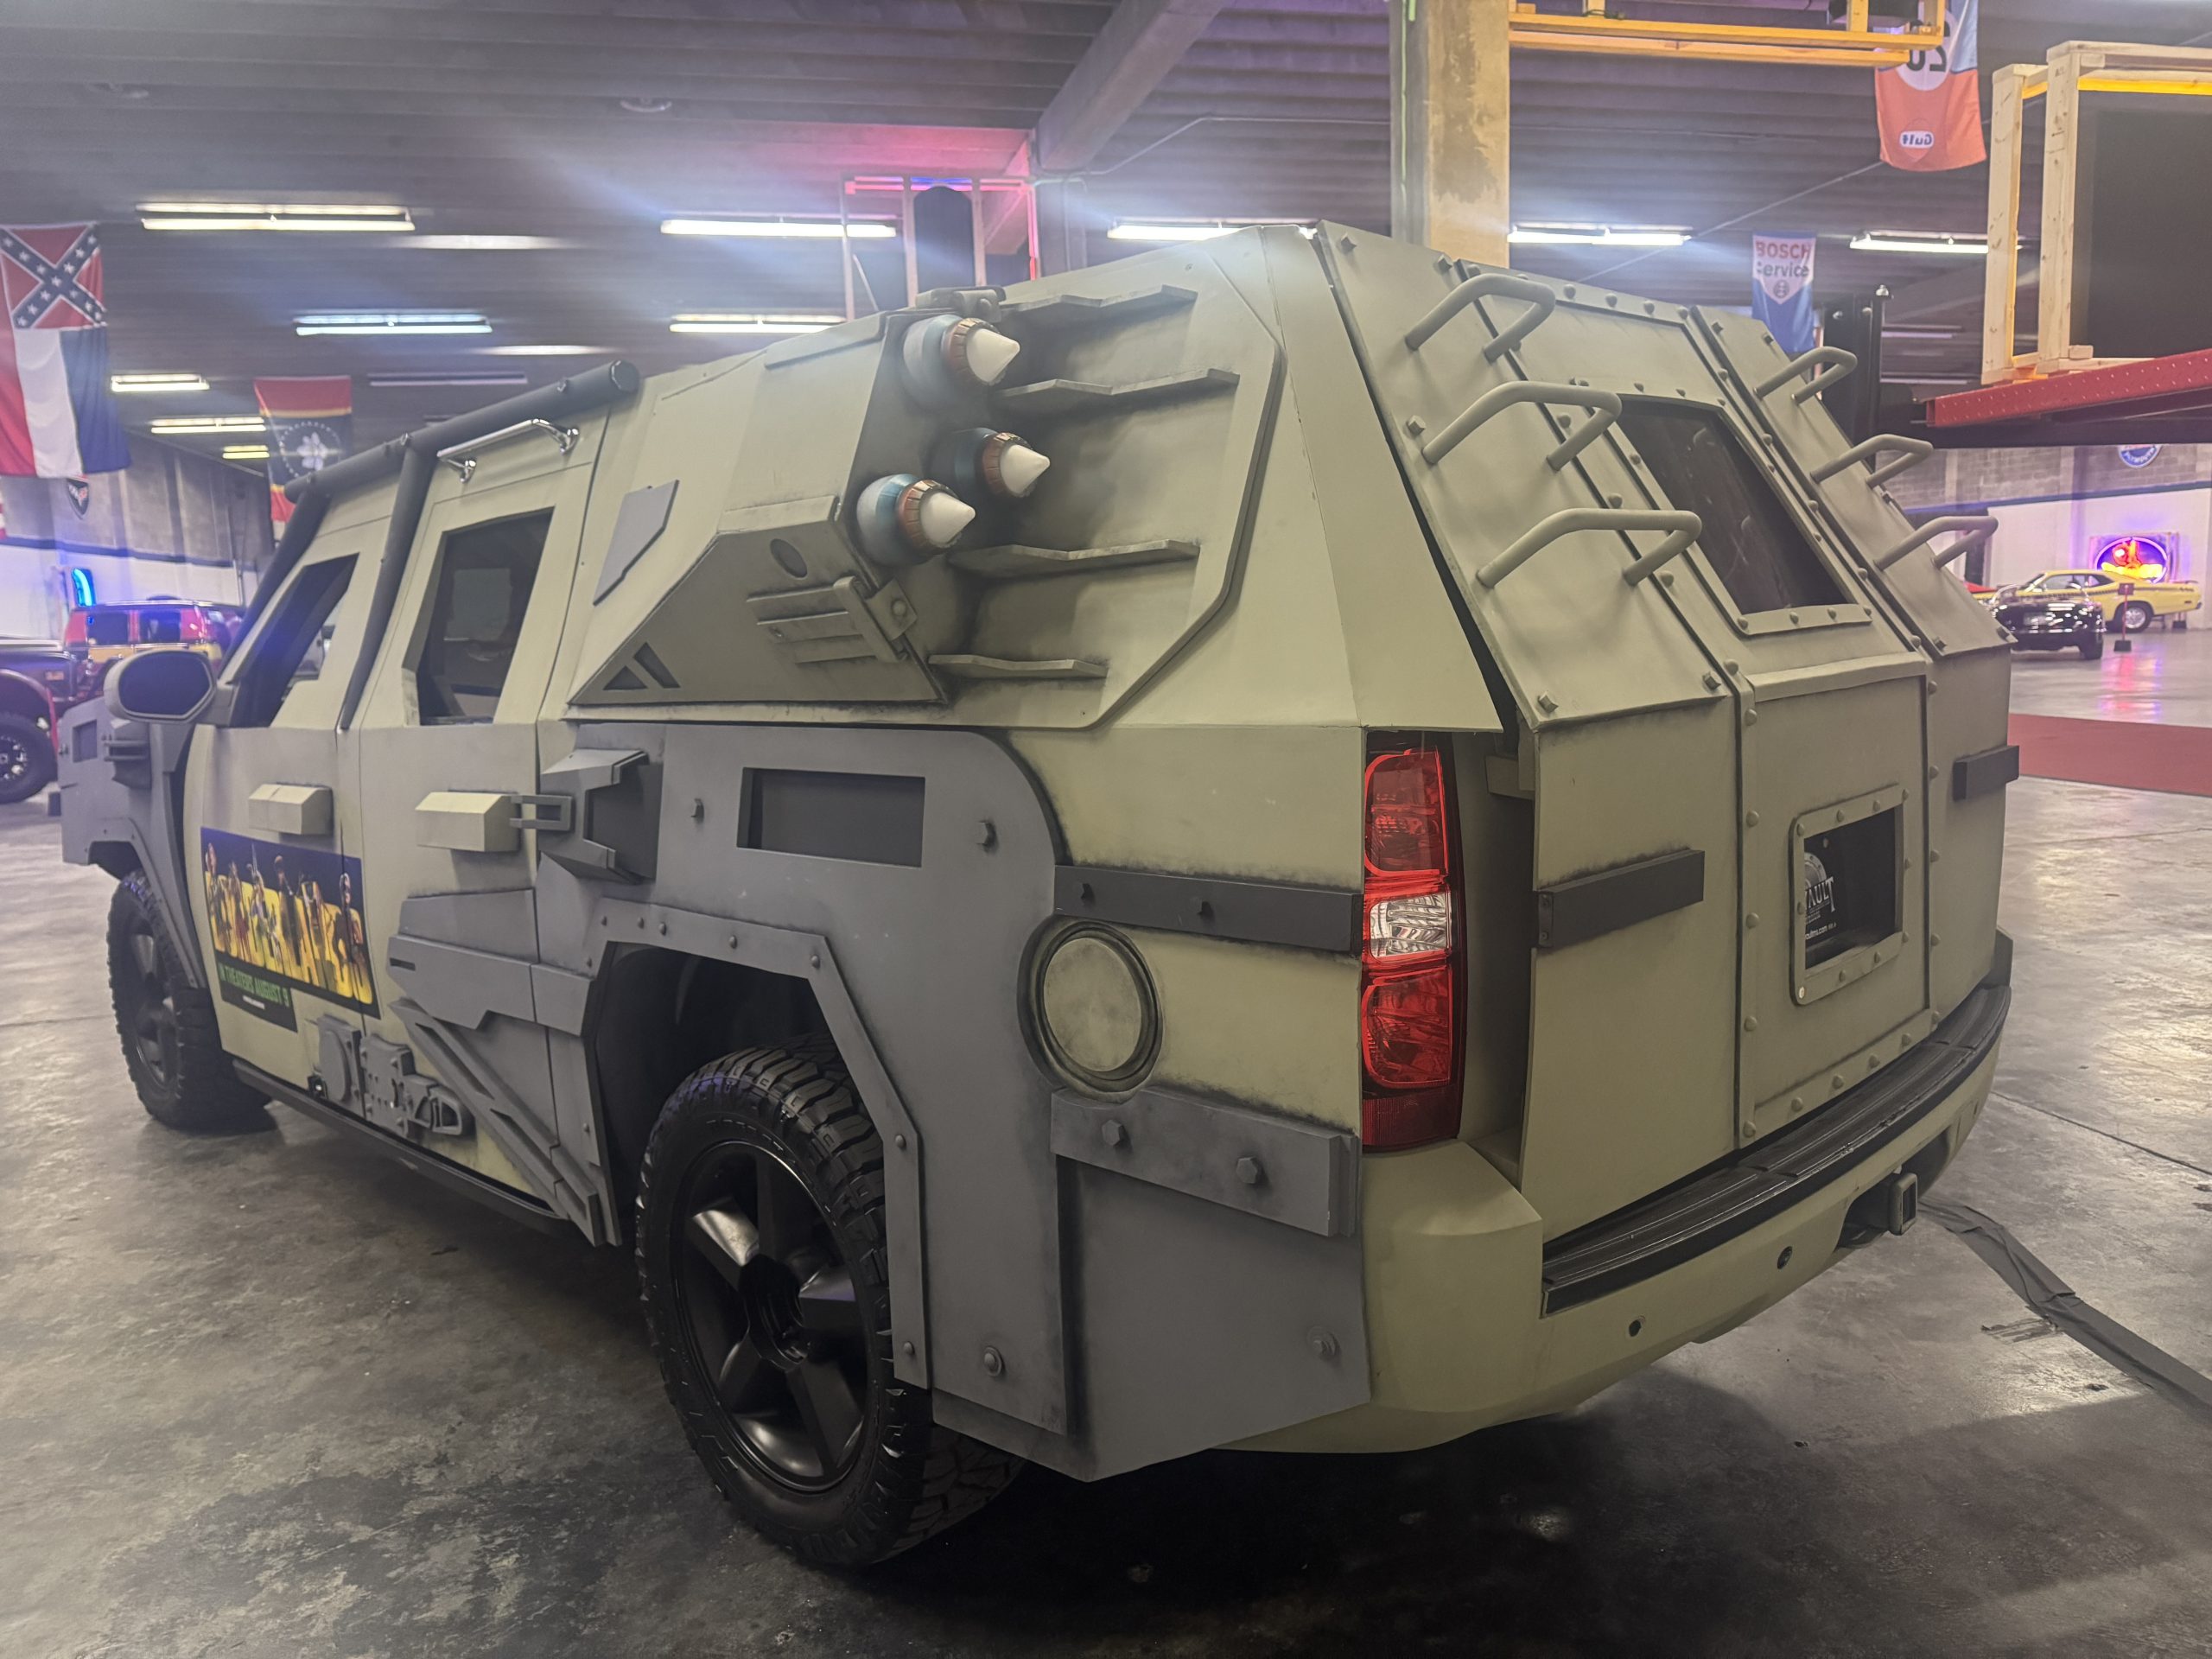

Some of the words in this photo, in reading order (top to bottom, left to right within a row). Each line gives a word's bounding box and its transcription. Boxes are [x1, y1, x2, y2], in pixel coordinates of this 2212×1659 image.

[1755, 241, 1812, 259] BOSCH
[225, 964, 255, 995] THEATERS
[254, 977, 283, 1005] AUGUST
[282, 987, 290, 1008] 9
